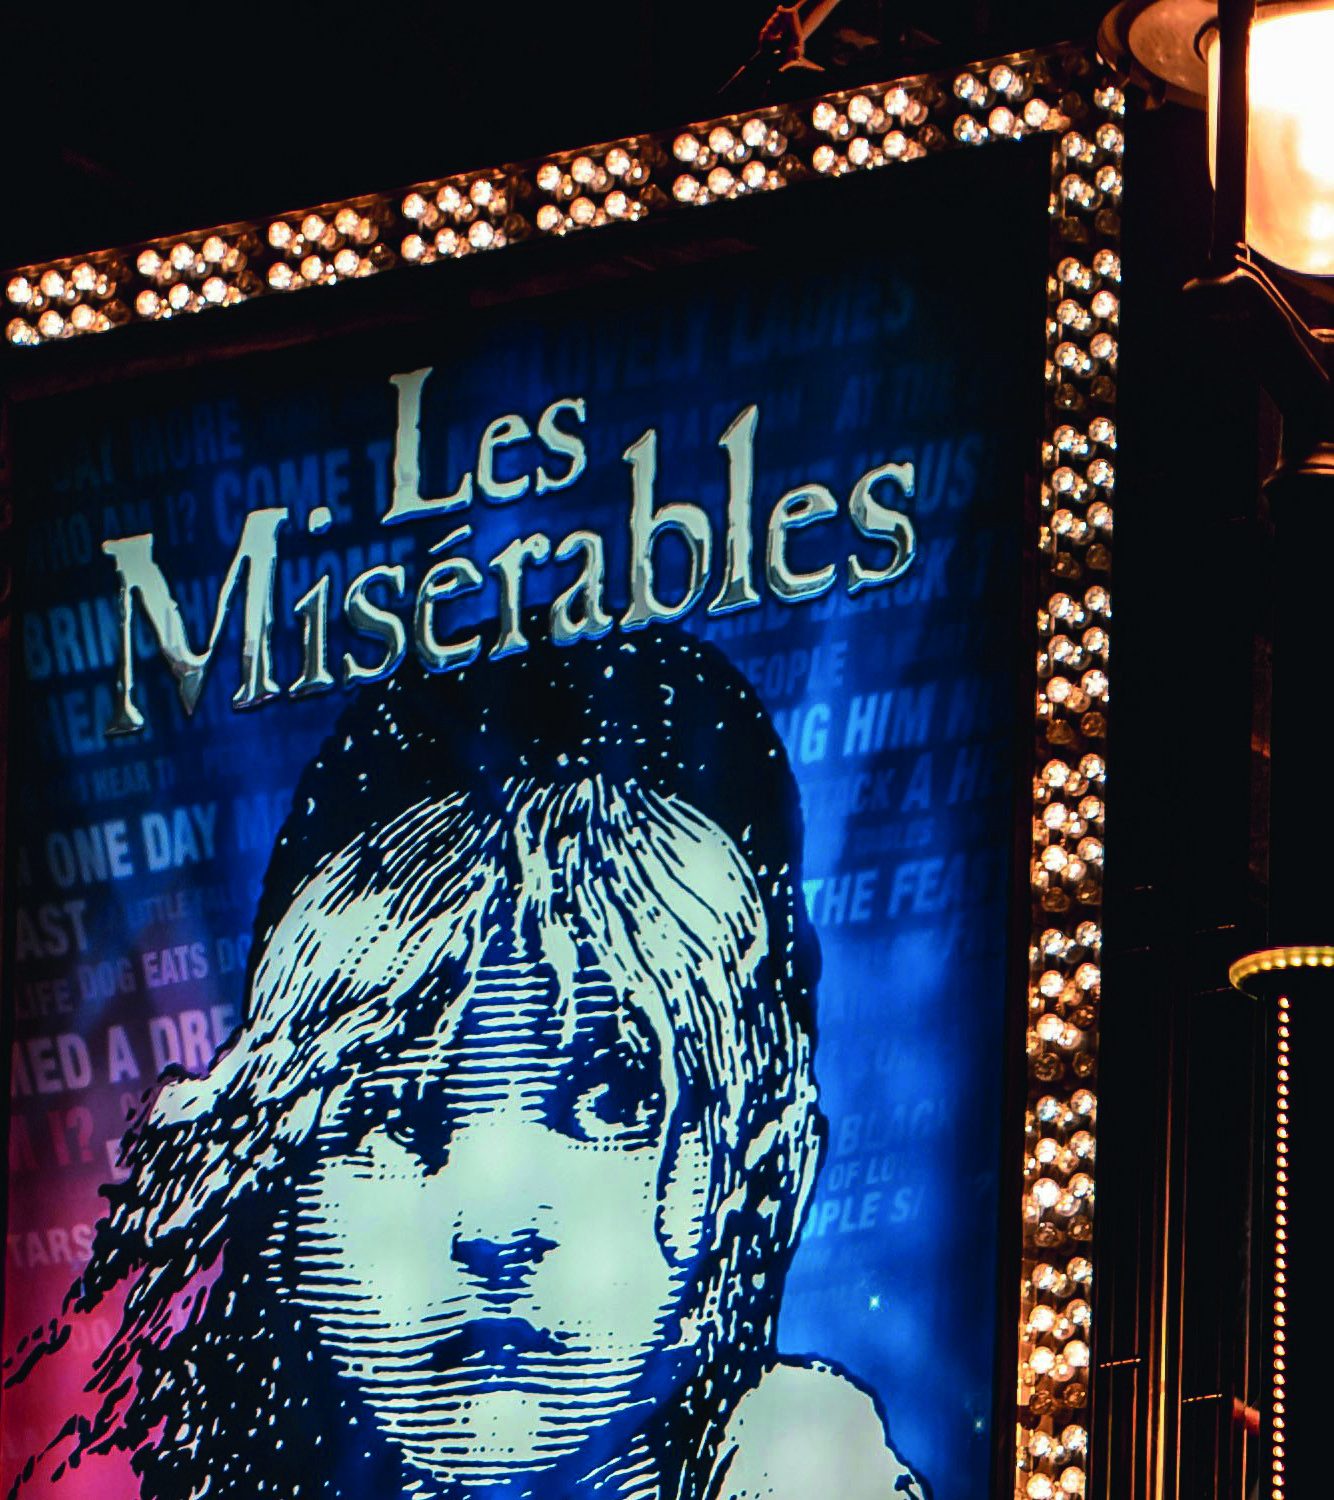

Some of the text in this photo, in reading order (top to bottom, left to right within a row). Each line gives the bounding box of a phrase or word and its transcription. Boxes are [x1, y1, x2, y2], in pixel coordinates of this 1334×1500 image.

[379, 367, 586, 527] Les
[102, 405, 917, 737] Misérables
[46, 818, 134, 889] ONE
[141, 801, 217, 873] DAY
[142, 943, 209, 989] EATS
[108, 1025, 141, 1084] A
